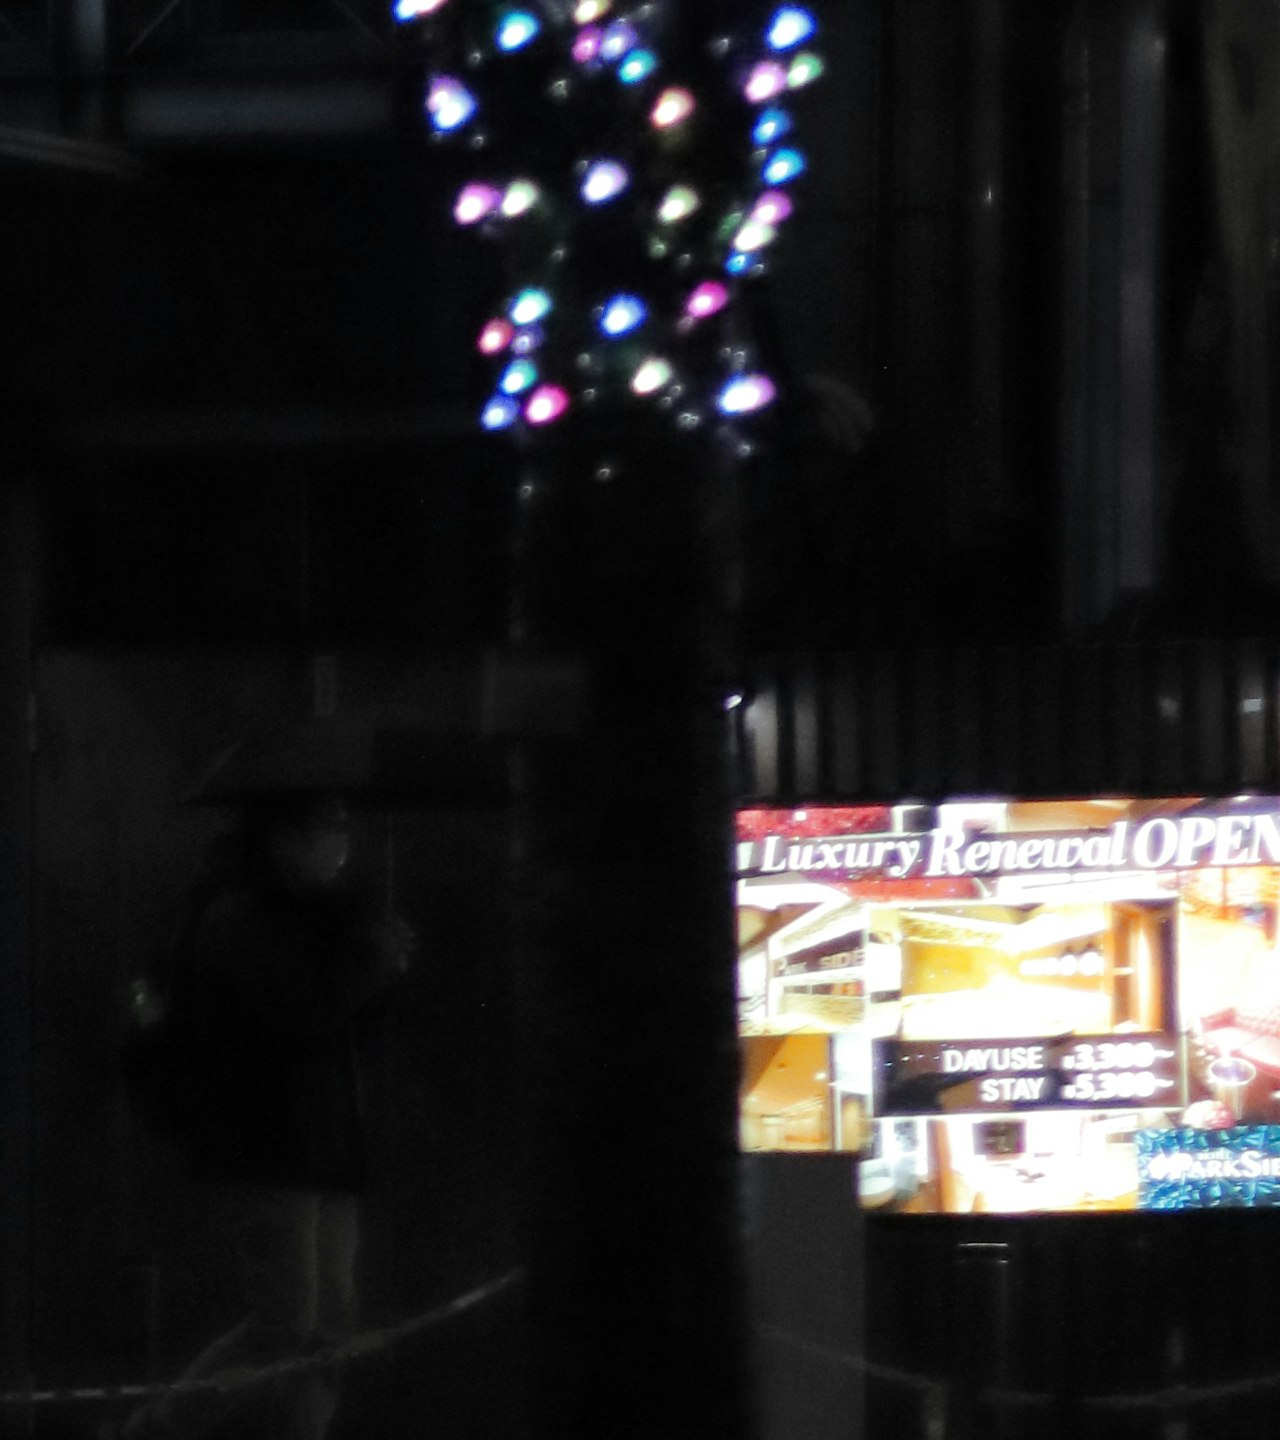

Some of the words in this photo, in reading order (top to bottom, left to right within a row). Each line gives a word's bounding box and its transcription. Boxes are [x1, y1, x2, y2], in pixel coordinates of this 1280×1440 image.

[760, 836, 920, 877] Luxury
[925, 821, 1127, 877] Renewal
[943, 1046, 1043, 1072] DAYUSE
[981, 1077, 1044, 1102] STAY
